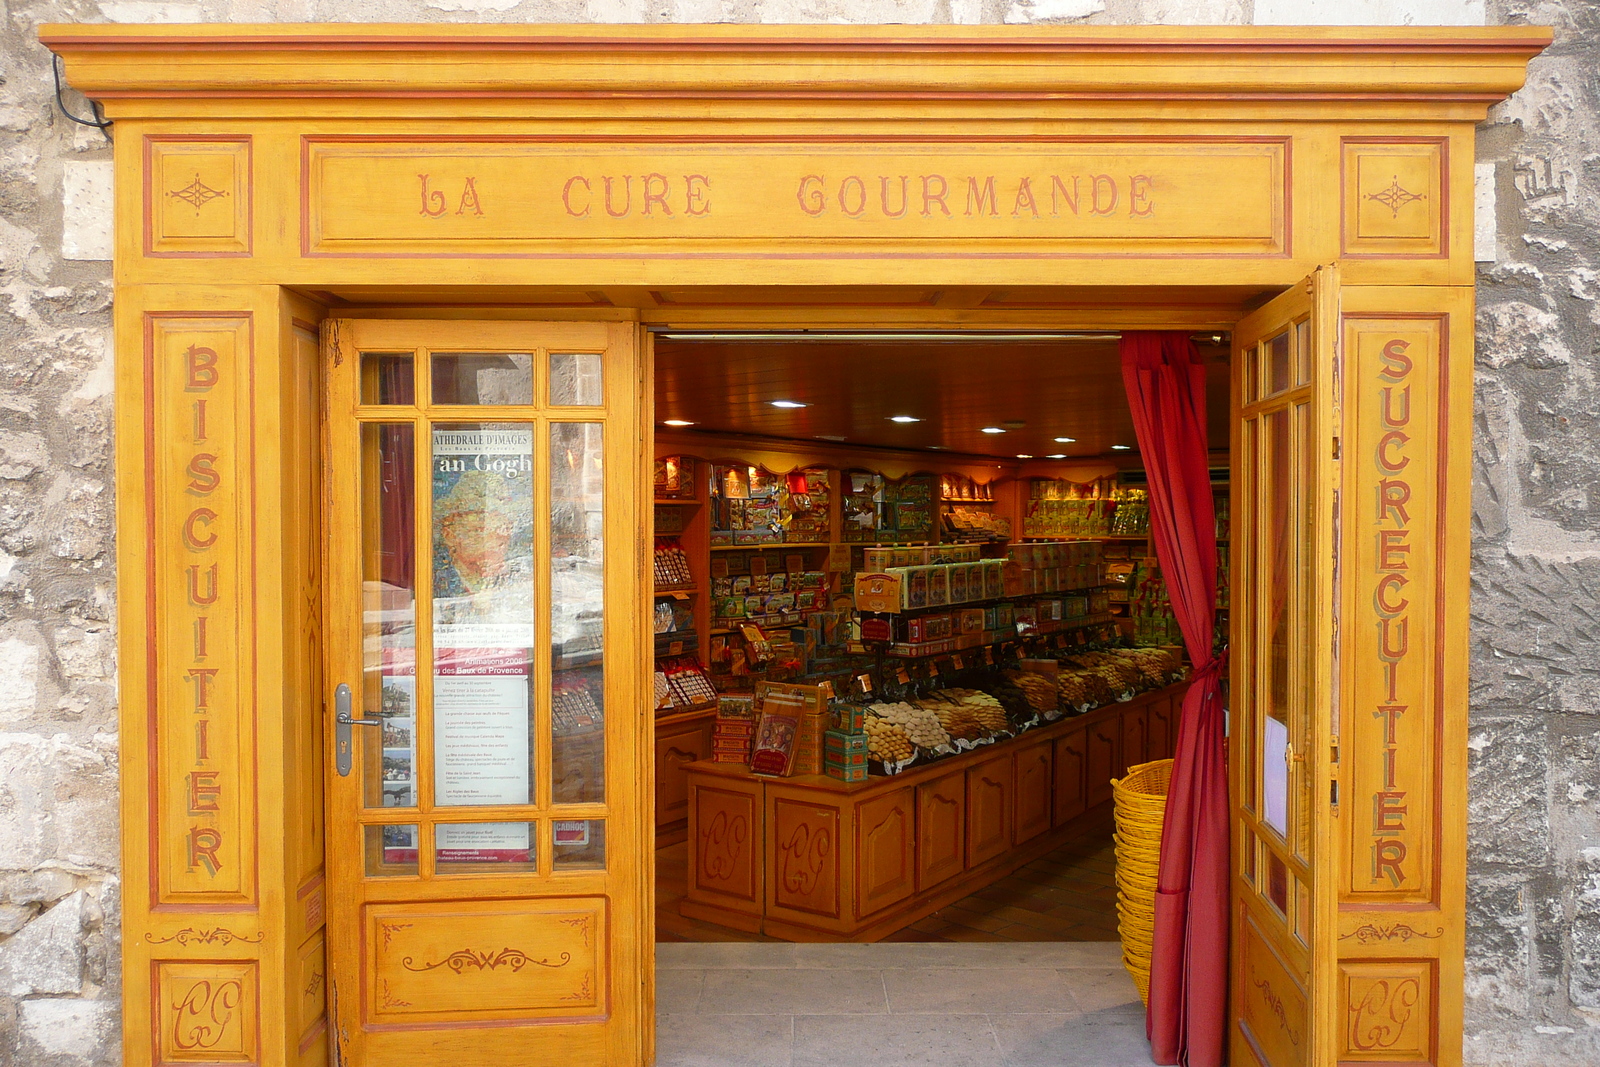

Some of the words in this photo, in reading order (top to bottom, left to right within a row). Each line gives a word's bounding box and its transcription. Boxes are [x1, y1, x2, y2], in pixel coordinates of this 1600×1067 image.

[417, 173, 485, 218] LA
[561, 172, 713, 219] CURE
[796, 173, 1155, 219] GOURMANDE
[434, 434, 484, 446] ATHEDRALE
[440, 458, 466, 472] an
[474, 454, 532, 479] Gogh
[184, 343, 223, 877] BISCUITIER
[1371, 339, 1413, 887] SUCRECUITIER
